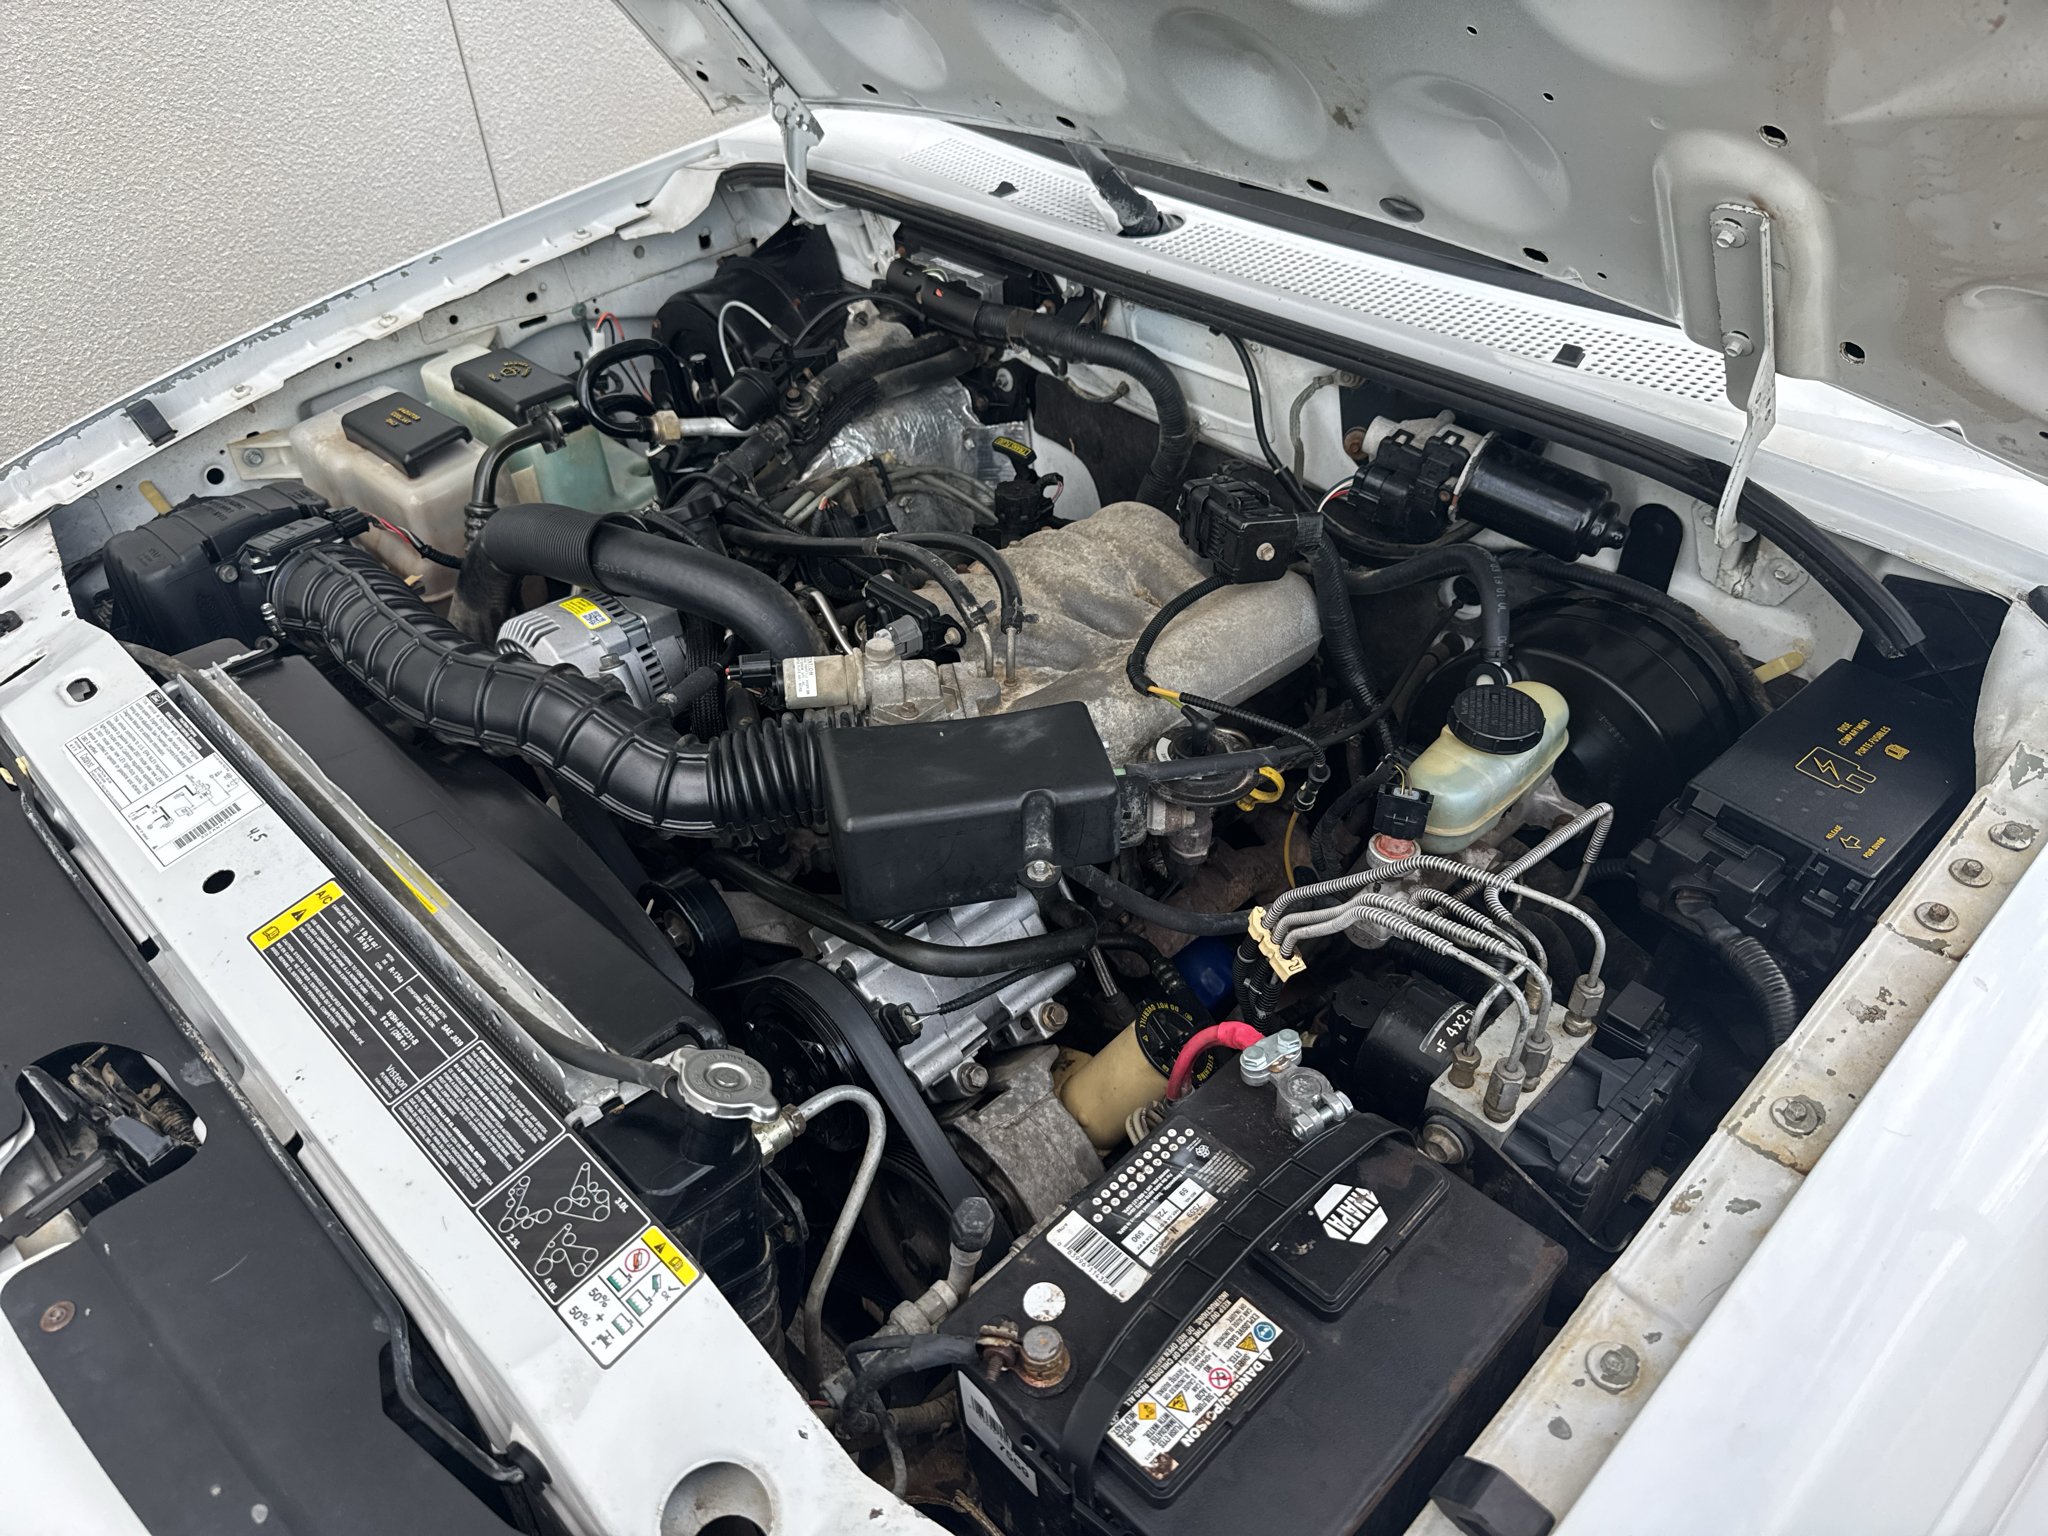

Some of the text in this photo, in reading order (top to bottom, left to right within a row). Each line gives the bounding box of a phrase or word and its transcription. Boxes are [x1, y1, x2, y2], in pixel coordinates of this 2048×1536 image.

[1836, 720, 1852, 734] FUSE
[1838, 717, 1871, 746] COMPARTMENT
[247, 827, 268, 842] 4.5
[1824, 824, 1844, 839] RELEASE
[314, 888, 334, 905] A/C
[387, 966, 405, 983] R-134a
[1139, 1003, 1154, 1028] OVERFILL
[1170, 1003, 1178, 1012] DO
[385, 1009, 420, 1046] WSH-M1C231-B
[440, 1022, 464, 1047] SAE J639
[1196, 1054, 1214, 1080] STEERING
[384, 1063, 410, 1090] Visteon
[1144, 1183, 1152, 1192] call
[613, 1196, 630, 1213] 3.0L
[1185, 1202, 1202, 1218] 7559
[1325, 1190, 1375, 1236] NAPA
[1130, 1186, 1188, 1243] 59 725 590
[506, 1232, 521, 1249] 2.3L
[1066, 1248, 1088, 1267] 83996
[1087, 1266, 1108, 1285] 11439
[542, 1276, 559, 1294] 4.0L
[587, 1286, 610, 1310] 50%
[660, 1290, 671, 1301] OK
[1215, 1298, 1232, 1313] KEEP
[1238, 1302, 1247, 1310] OR
[568, 1303, 592, 1328] 50%
[1162, 1290, 1229, 1358] INSTRUCTIONS. DO NOT OPEN
[1199, 1319, 1210, 1329] OF
[1206, 1309, 1220, 1323] OUT
[1191, 1325, 1205, 1338] THE
[1212, 1306, 1253, 1347] CAN CAUSE BLINDNESS
[1222, 1312, 1259, 1349] EXPLOSIVE GASES
[1176, 1334, 1196, 1353] REACH
[1170, 1350, 1181, 1360] OF
[1226, 1350, 1243, 1365] EYES.
[1232, 1352, 1251, 1370] SHIELD
[1146, 1356, 1174, 1385] CHILDREN.
[1202, 1363, 1212, 1373] NO
[1132, 1381, 1150, 1398] READ
[1154, 1367, 1184, 1397] SEVERE BURNS.
[1162, 1372, 1190, 1401] BLINDNESS OR
[1180, 1377, 1196, 1392] CAUSE
[1191, 1382, 1201, 1392] CAN
[1123, 1394, 1137, 1408] ALL
[1194, 1386, 1208, 1400] ACID
[1179, 1359, 1265, 1447] DANGER/POISON
[1190, 1392, 1214, 1416] SULFURIC
[1122, 1409, 1137, 1424] HELP
[1156, 1411, 1170, 1425] WITH
[1110, 1421, 1126, 1436] FAST.
[1117, 1419, 1139, 1441] MEDICAL
[1142, 1421, 1160, 1440] WATER.
[1147, 1416, 1177, 1446] IMMEDIATELY
[1156, 1422, 1183, 1448] FLUSH EYES
[1123, 1434, 1136, 1447] GET
